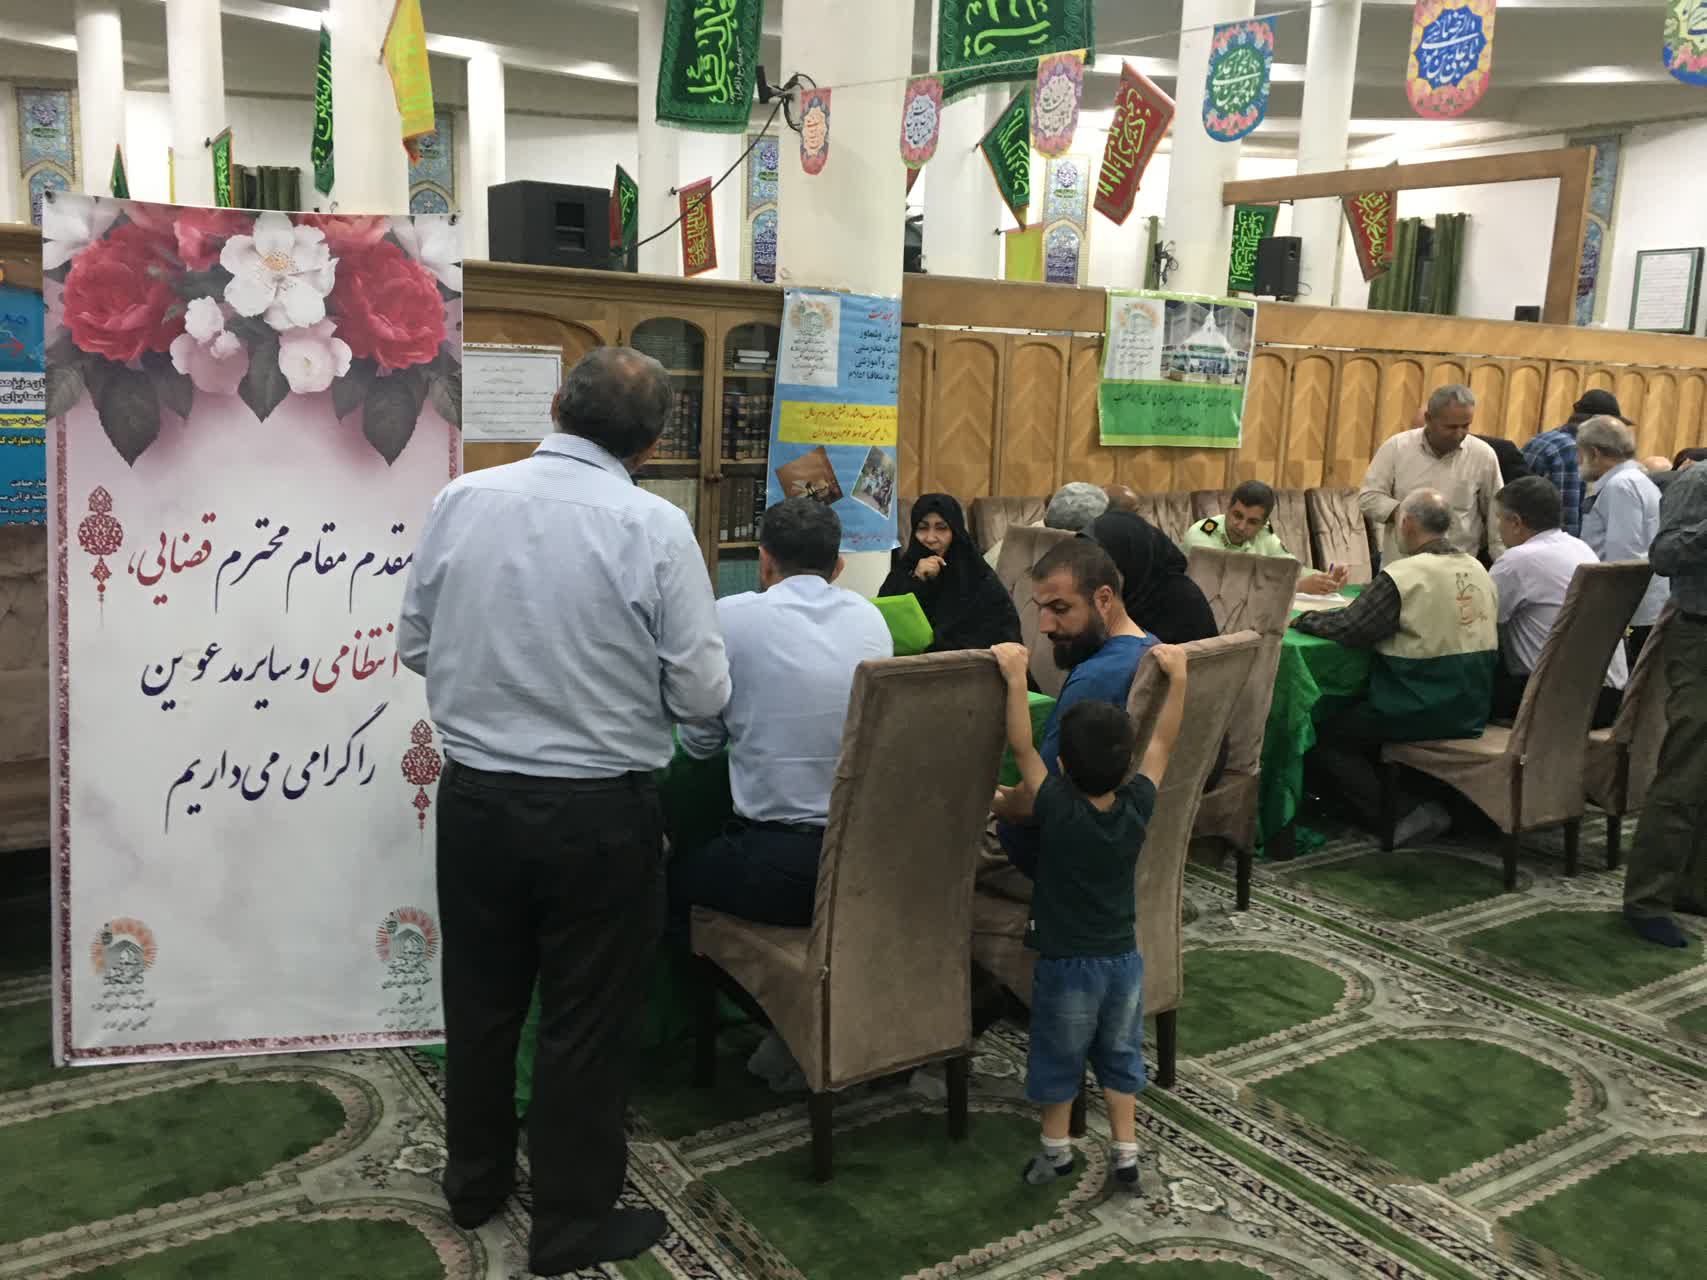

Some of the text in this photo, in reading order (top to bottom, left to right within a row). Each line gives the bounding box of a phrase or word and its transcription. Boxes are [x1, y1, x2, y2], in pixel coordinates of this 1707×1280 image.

[214, 518, 289, 613] محترم
[286, 521, 346, 613] مقام
[312, 623, 398, 693] انتظامی
[283, 702, 390, 799] گرامی
